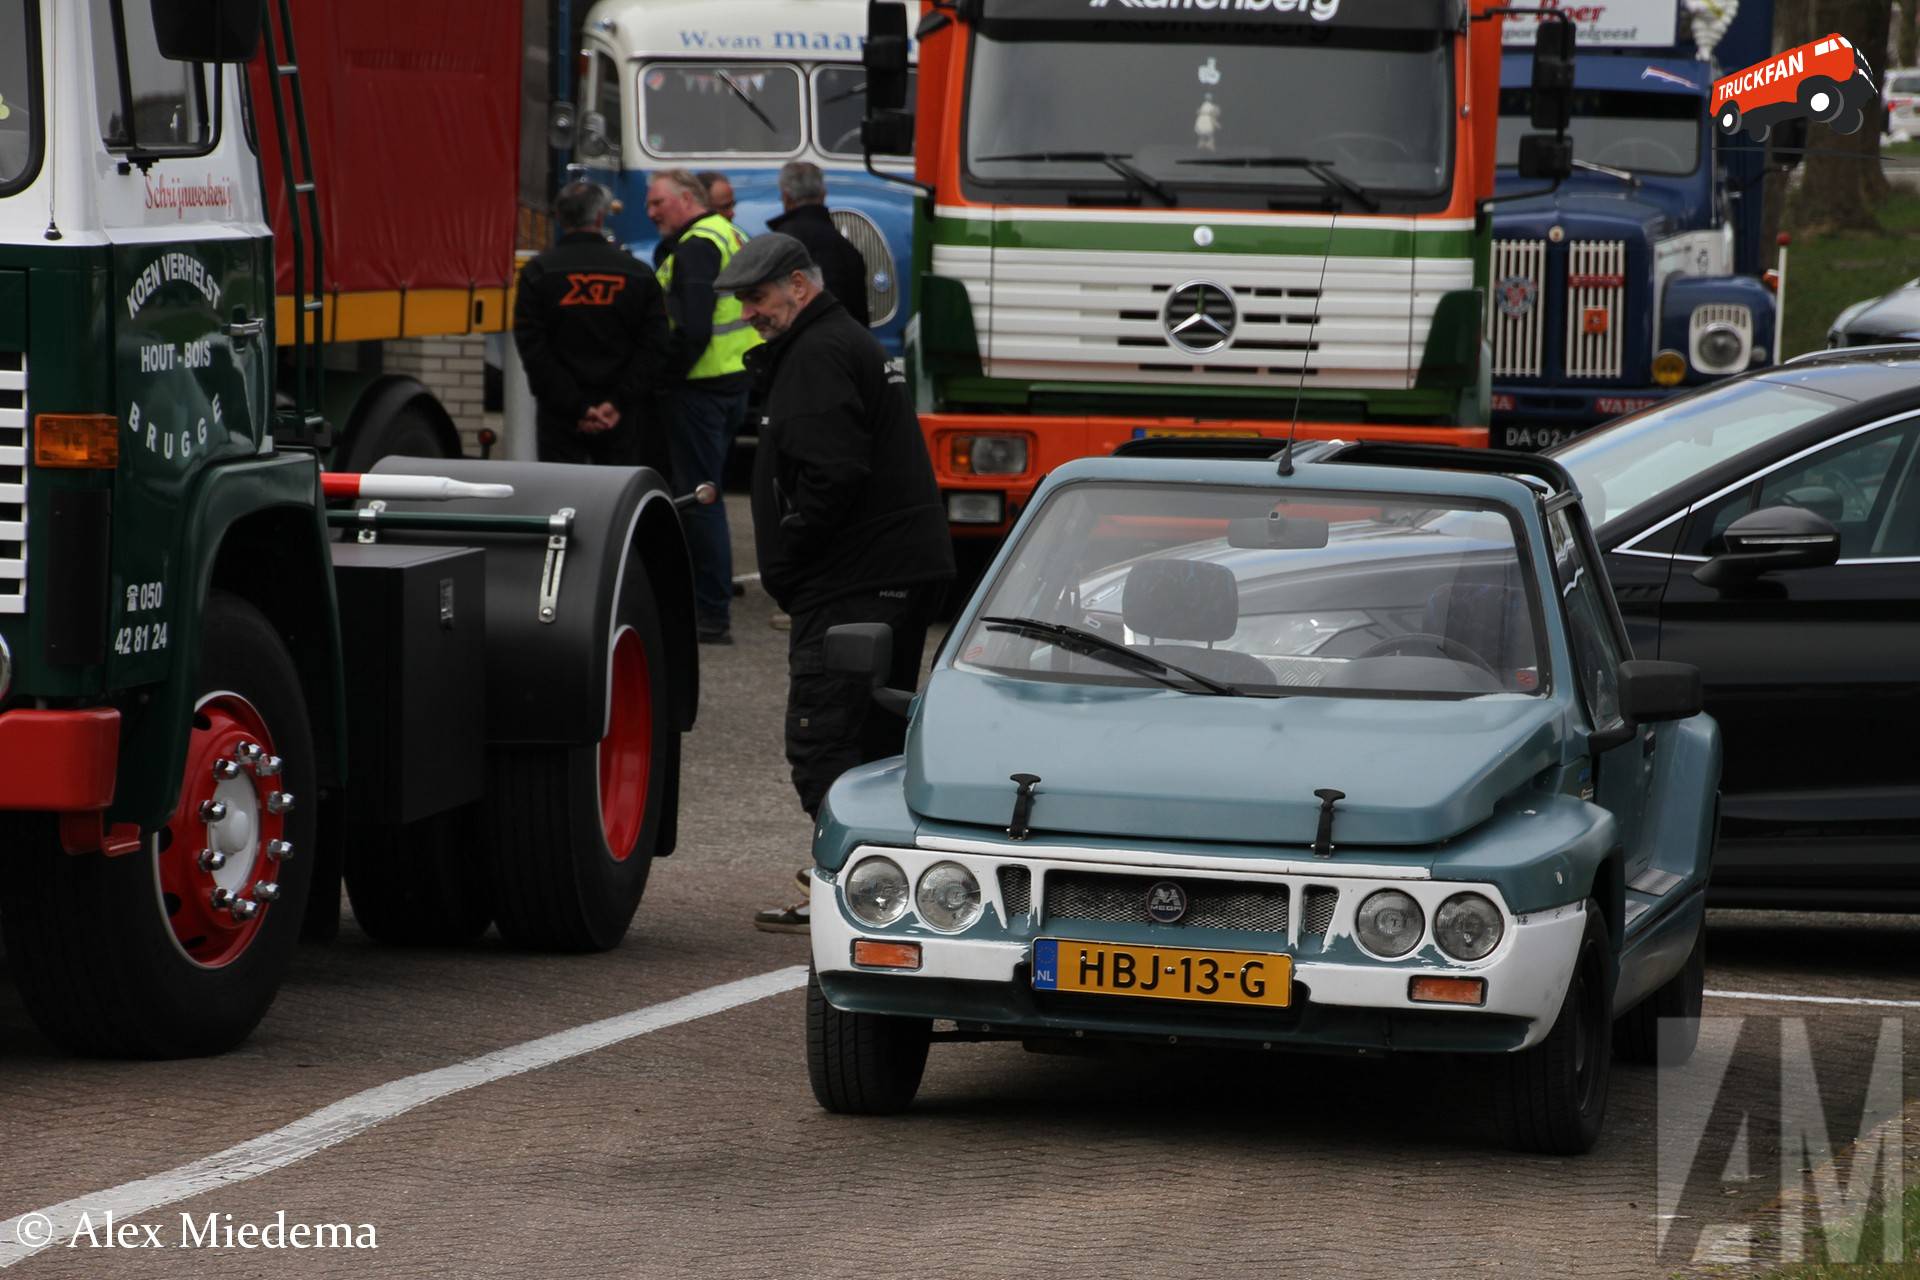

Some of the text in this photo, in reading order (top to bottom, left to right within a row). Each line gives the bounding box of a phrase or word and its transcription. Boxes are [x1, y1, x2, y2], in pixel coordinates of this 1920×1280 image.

[127, 253, 222, 320] KOEN VERHELST
[140, 581, 163, 610] 050
[114, 621, 168, 655] 42 81 24
[1037, 950, 1266, 998] NL HBJ-13-G
